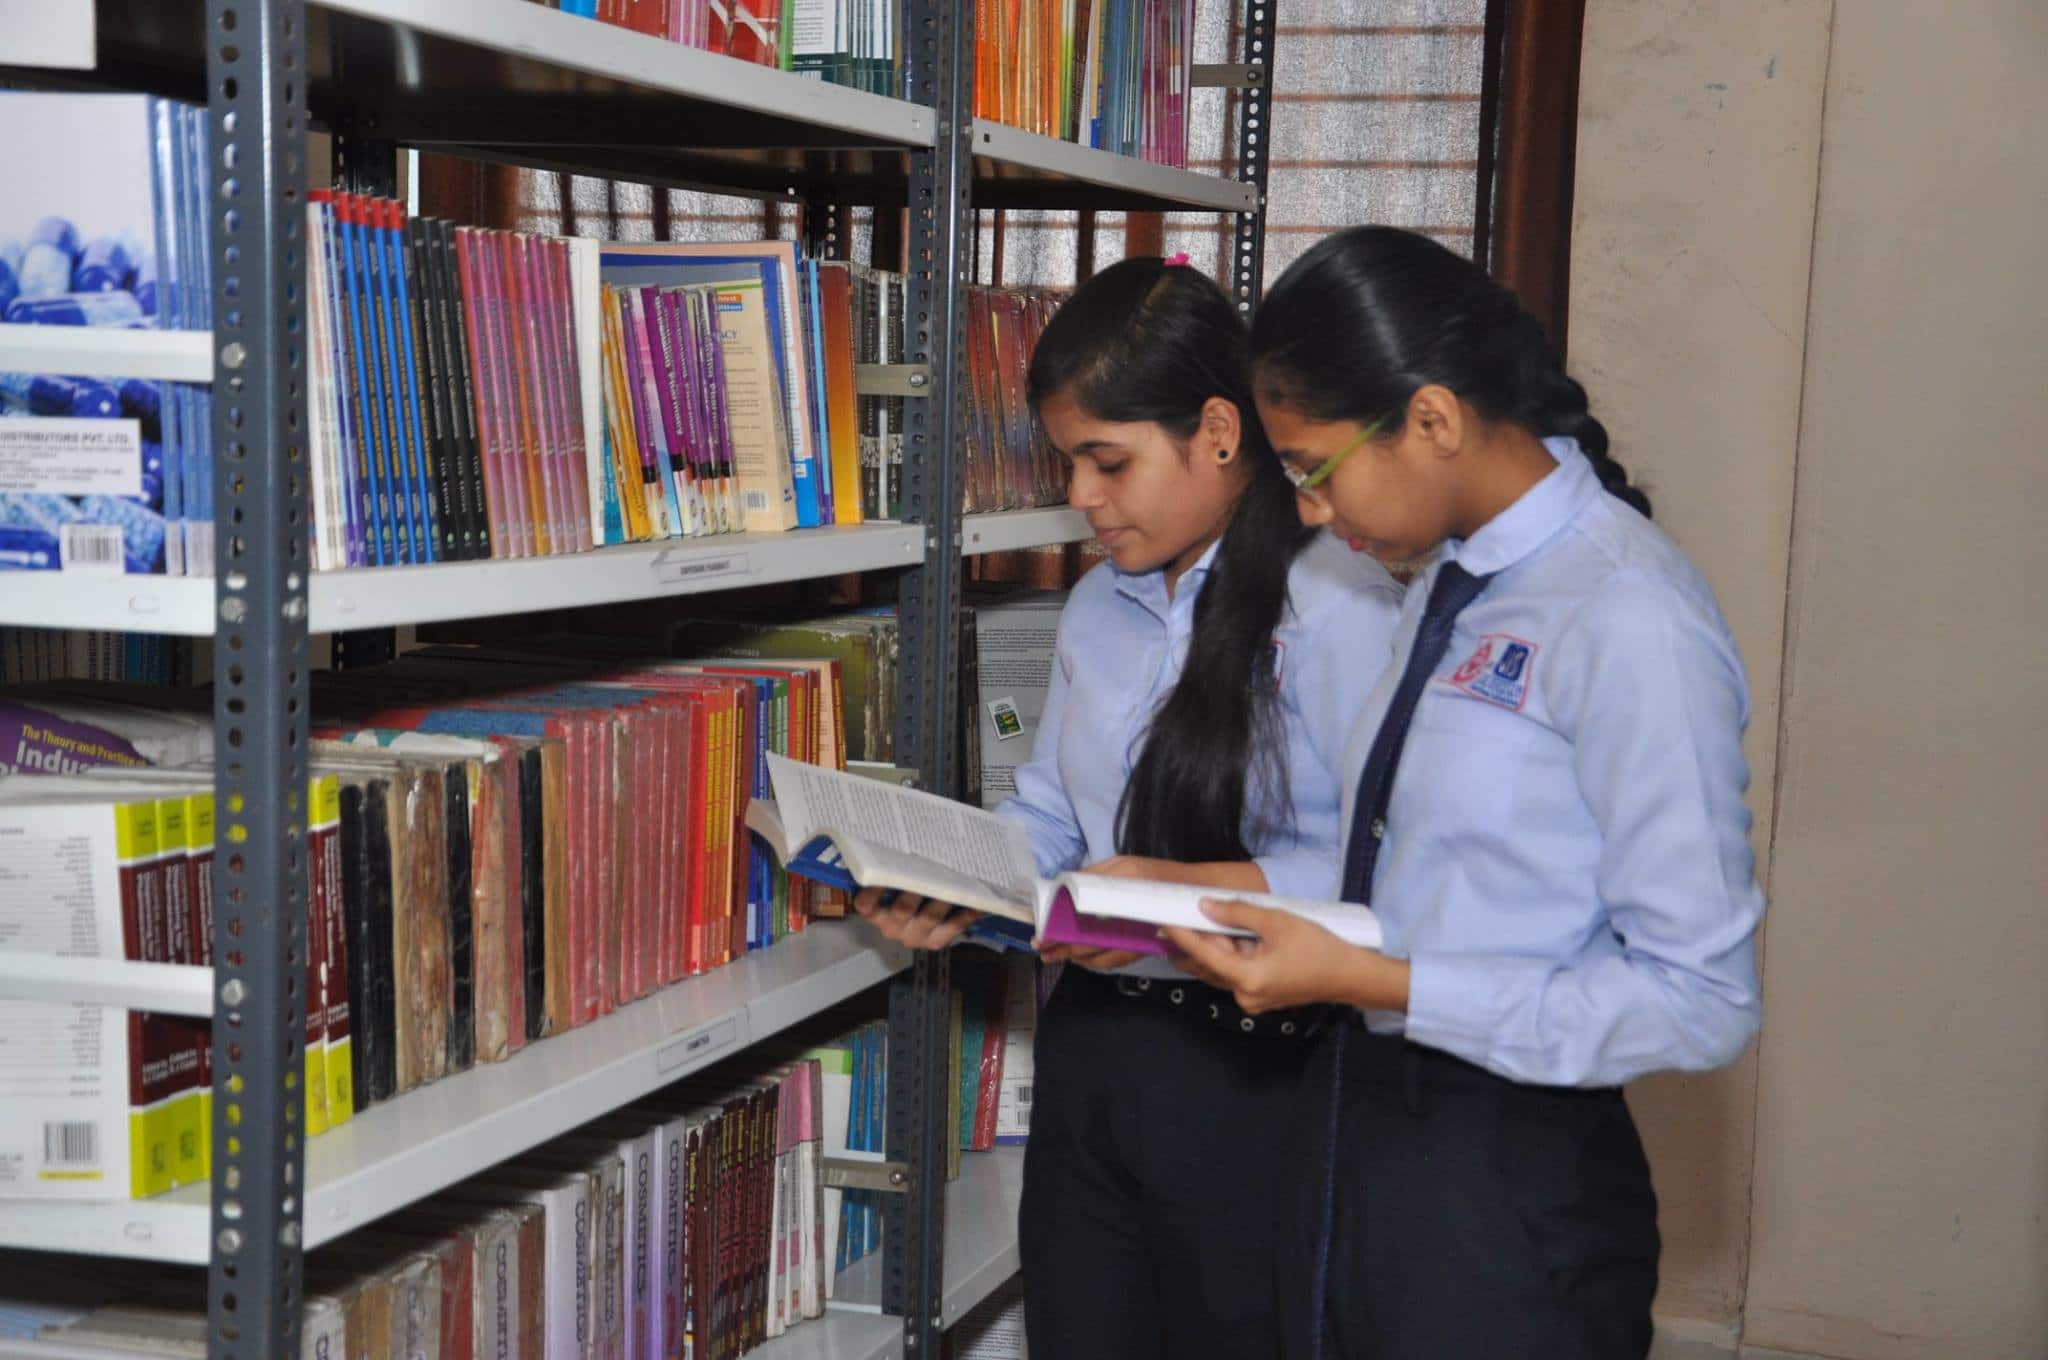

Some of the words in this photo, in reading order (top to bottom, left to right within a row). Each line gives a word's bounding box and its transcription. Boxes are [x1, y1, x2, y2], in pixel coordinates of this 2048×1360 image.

[23, 724, 40, 741] The
[43, 729, 77, 753] Theory
[77, 743, 97, 757] and
[575, 1200, 586, 1343] COSMETICS
[636, 1153, 649, 1293] COSMETICS
[668, 1139, 680, 1279] COSMETICS
